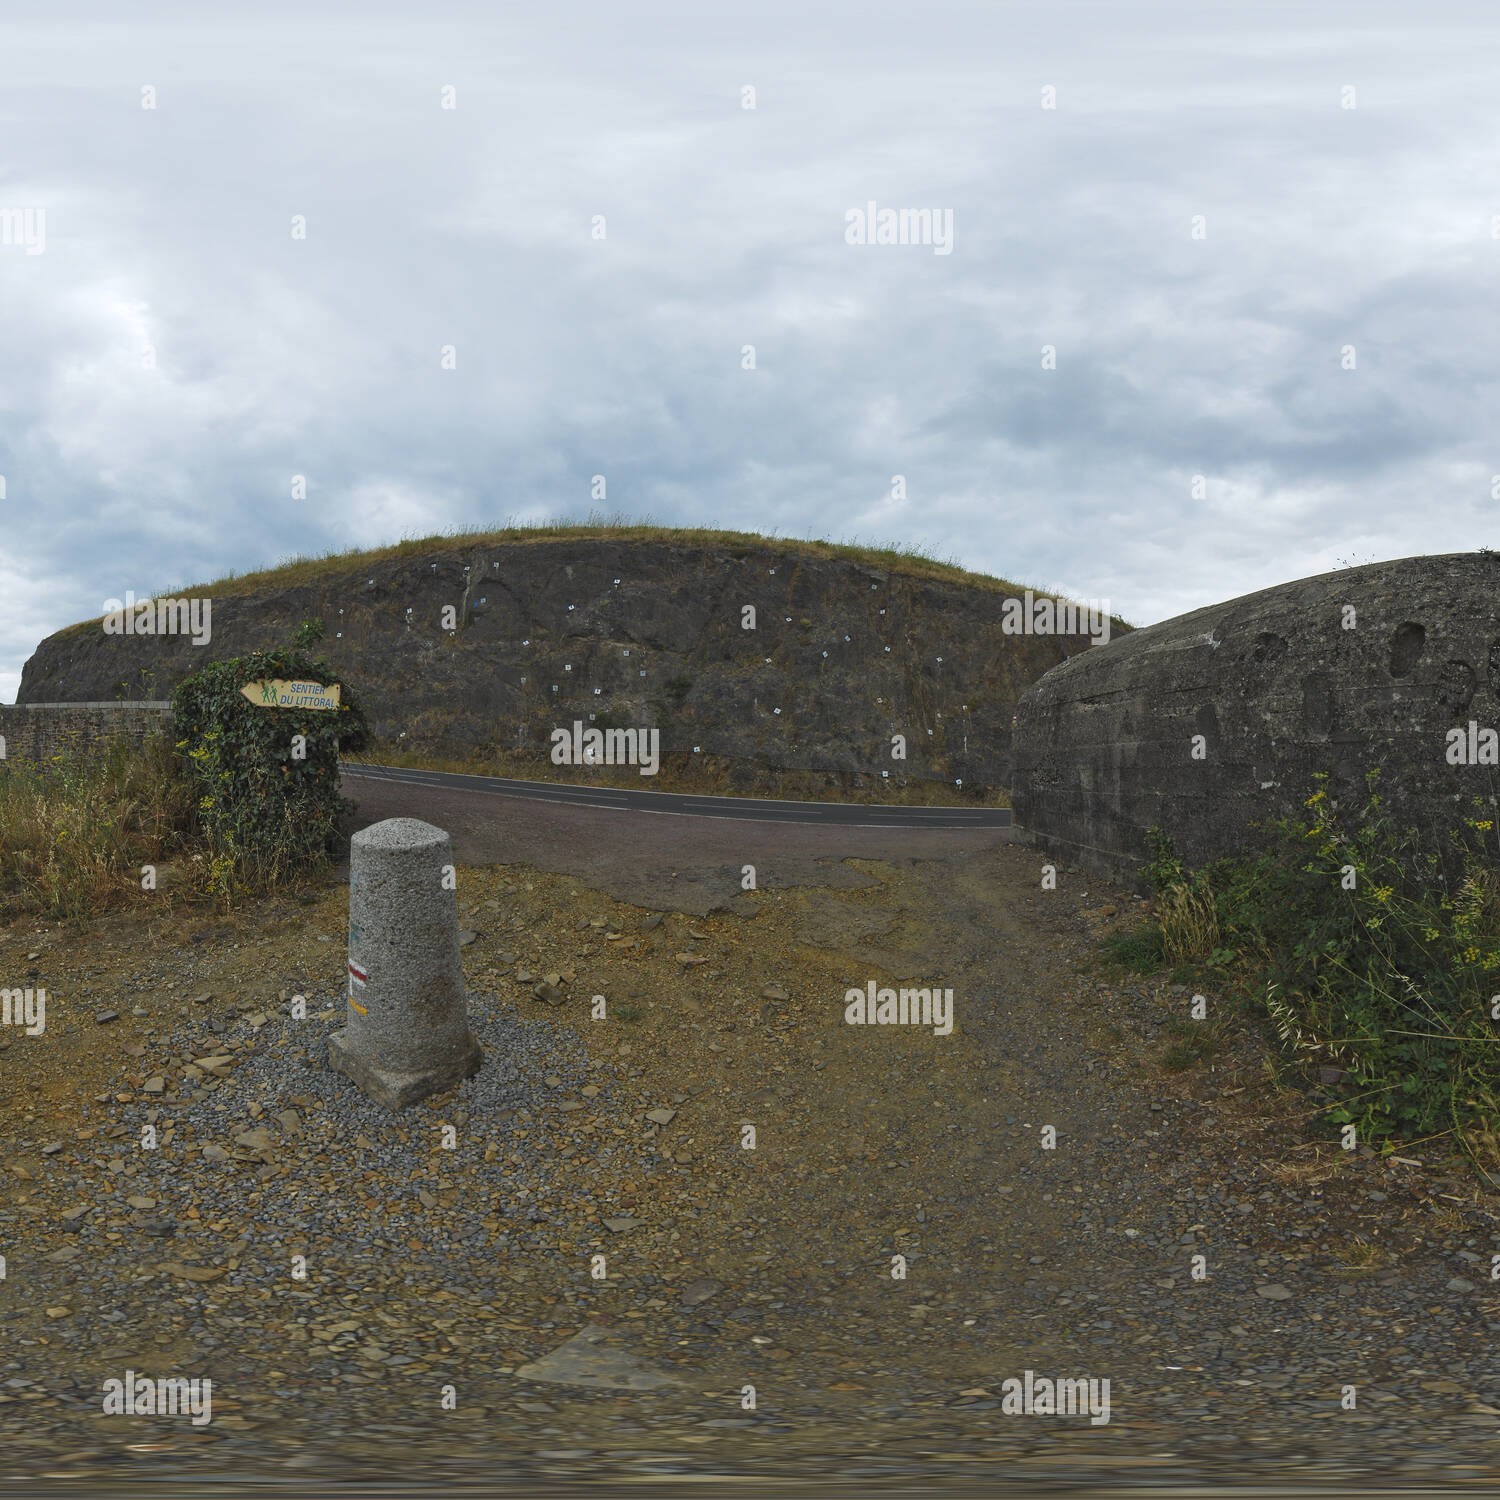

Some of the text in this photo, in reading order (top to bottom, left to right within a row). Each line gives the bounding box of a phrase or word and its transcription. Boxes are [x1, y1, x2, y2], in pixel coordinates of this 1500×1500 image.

[291, 683, 325, 694] SENTIER
[280, 695, 335, 707] DU LITTORAL
